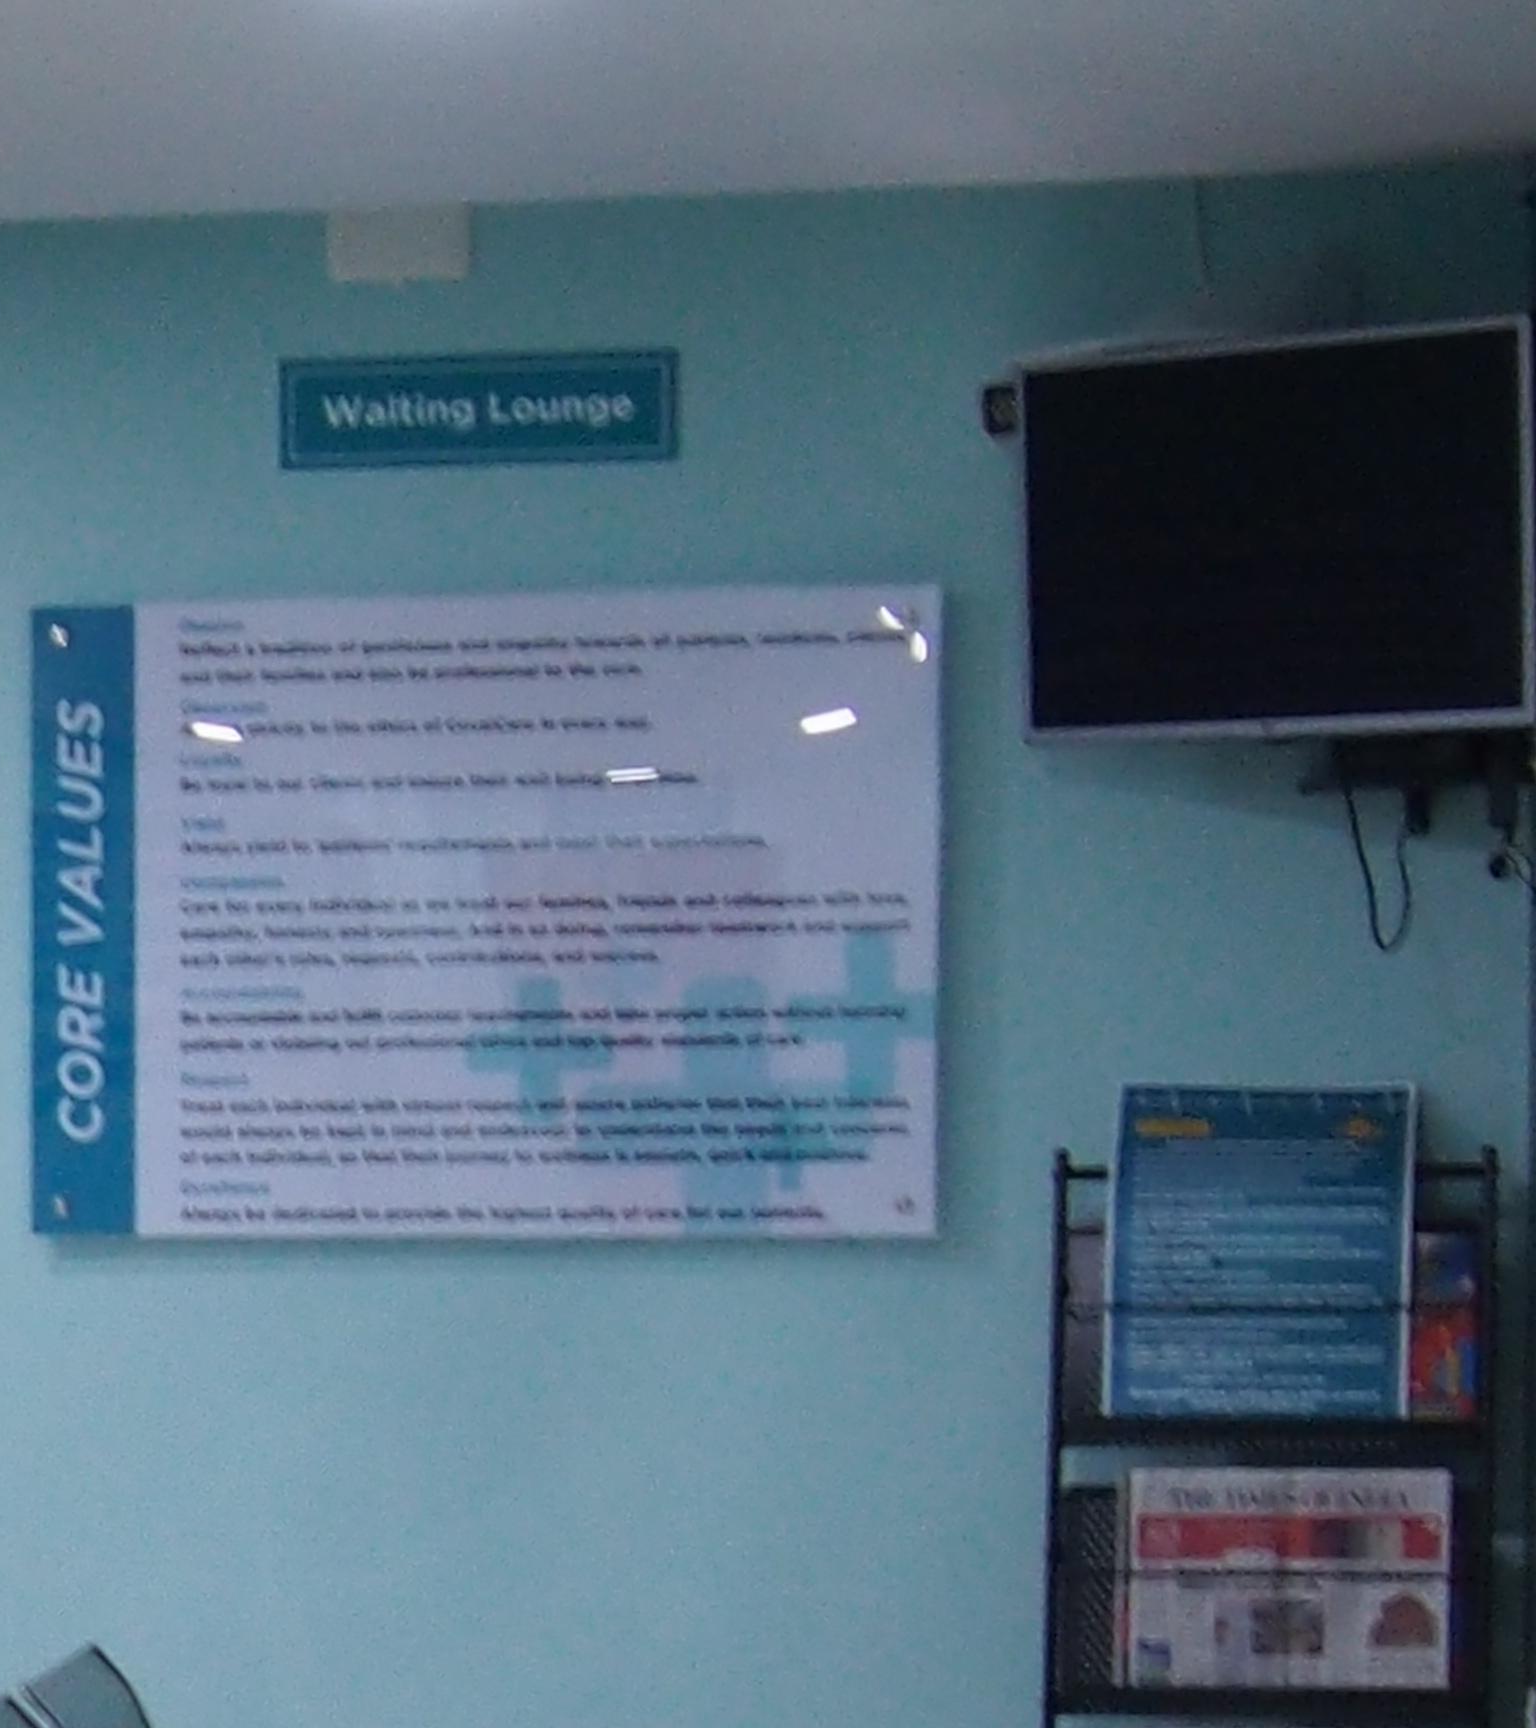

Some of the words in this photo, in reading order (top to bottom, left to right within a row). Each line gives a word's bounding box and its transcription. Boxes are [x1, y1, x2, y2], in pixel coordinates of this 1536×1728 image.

[323, 392, 476, 434] Waiting
[488, 390, 635, 428] Lounge
[56, 697, 106, 947] VALUES
[56, 963, 106, 1144] CORE
